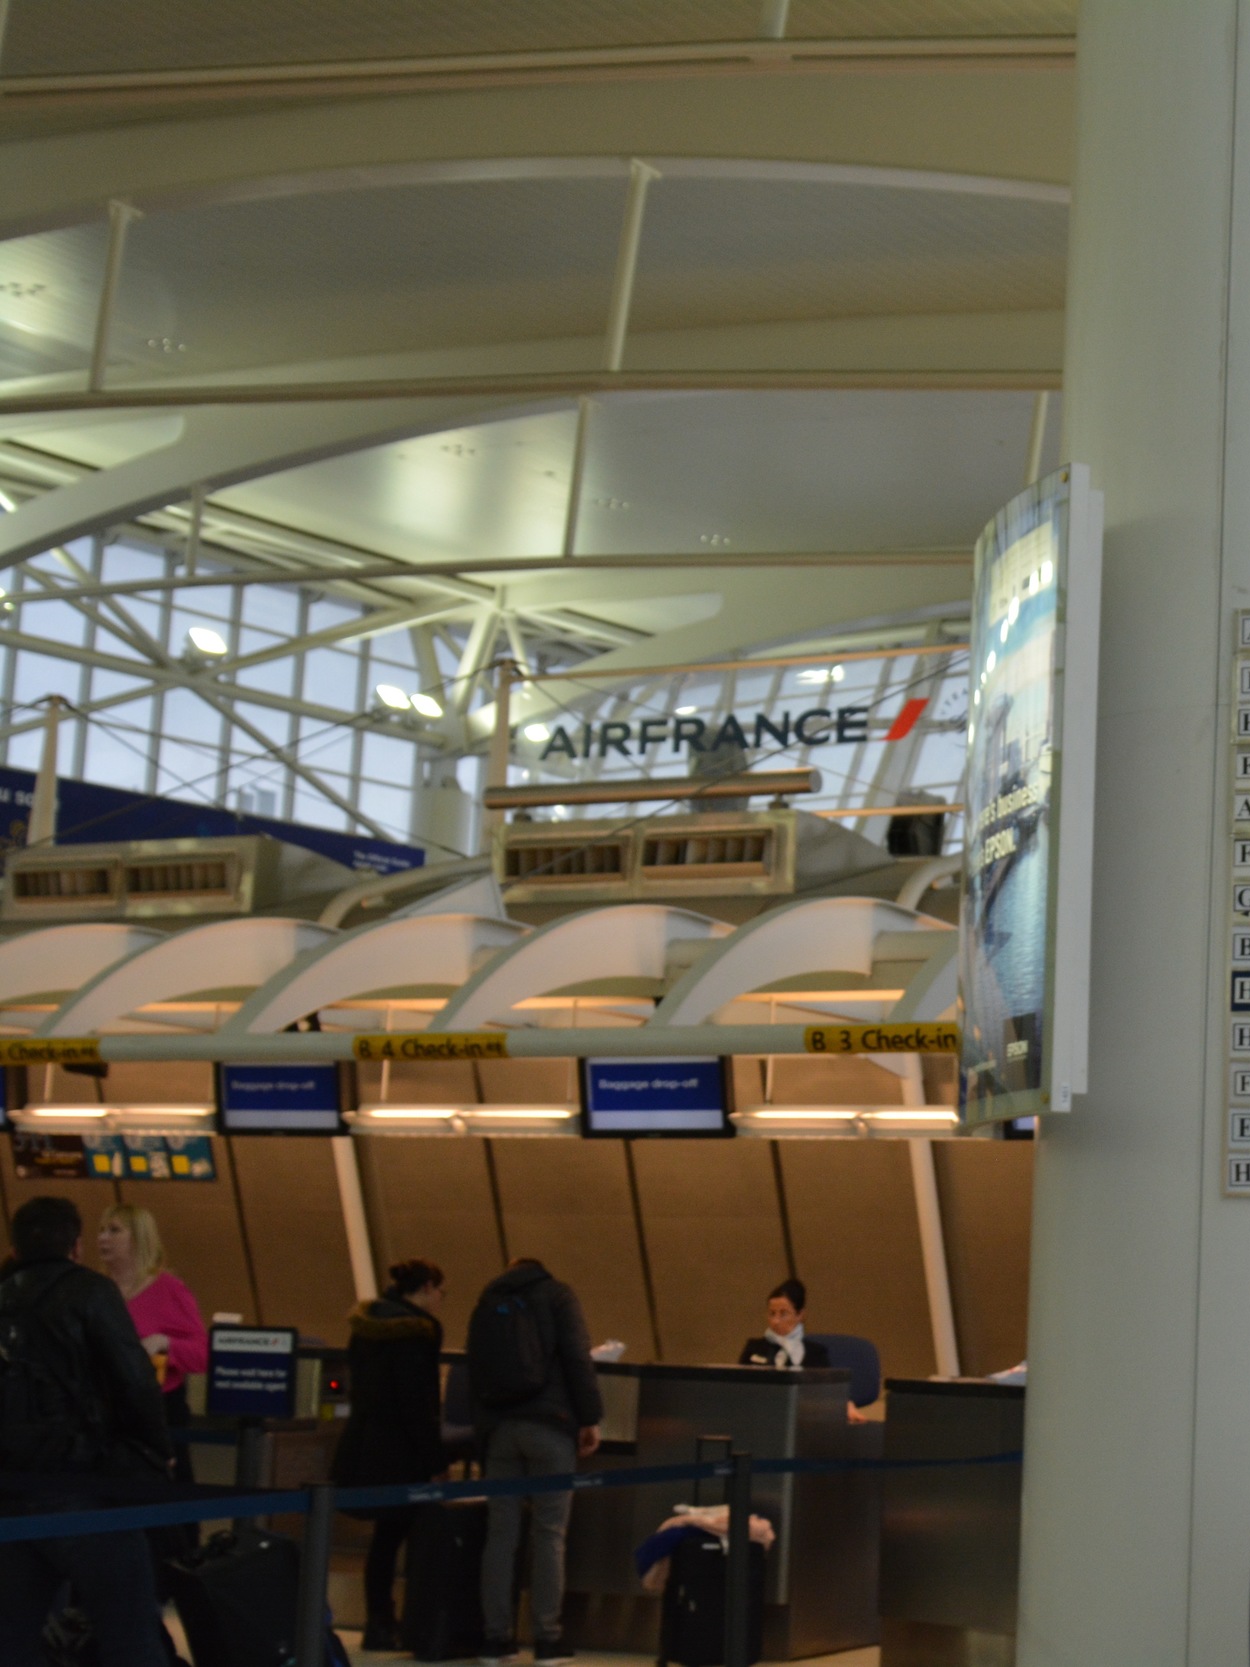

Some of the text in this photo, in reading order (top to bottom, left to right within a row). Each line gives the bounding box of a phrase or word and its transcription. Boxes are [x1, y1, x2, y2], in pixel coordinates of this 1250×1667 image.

[540, 705, 869, 760] AIRFRANCE
[359, 1037, 484, 1059] B 4 Check-in
[812, 1027, 957, 1051] B 3 Check-in
[599, 1078, 698, 1091] Baggage drop-off
[1235, 1163, 1250, 1182] H
